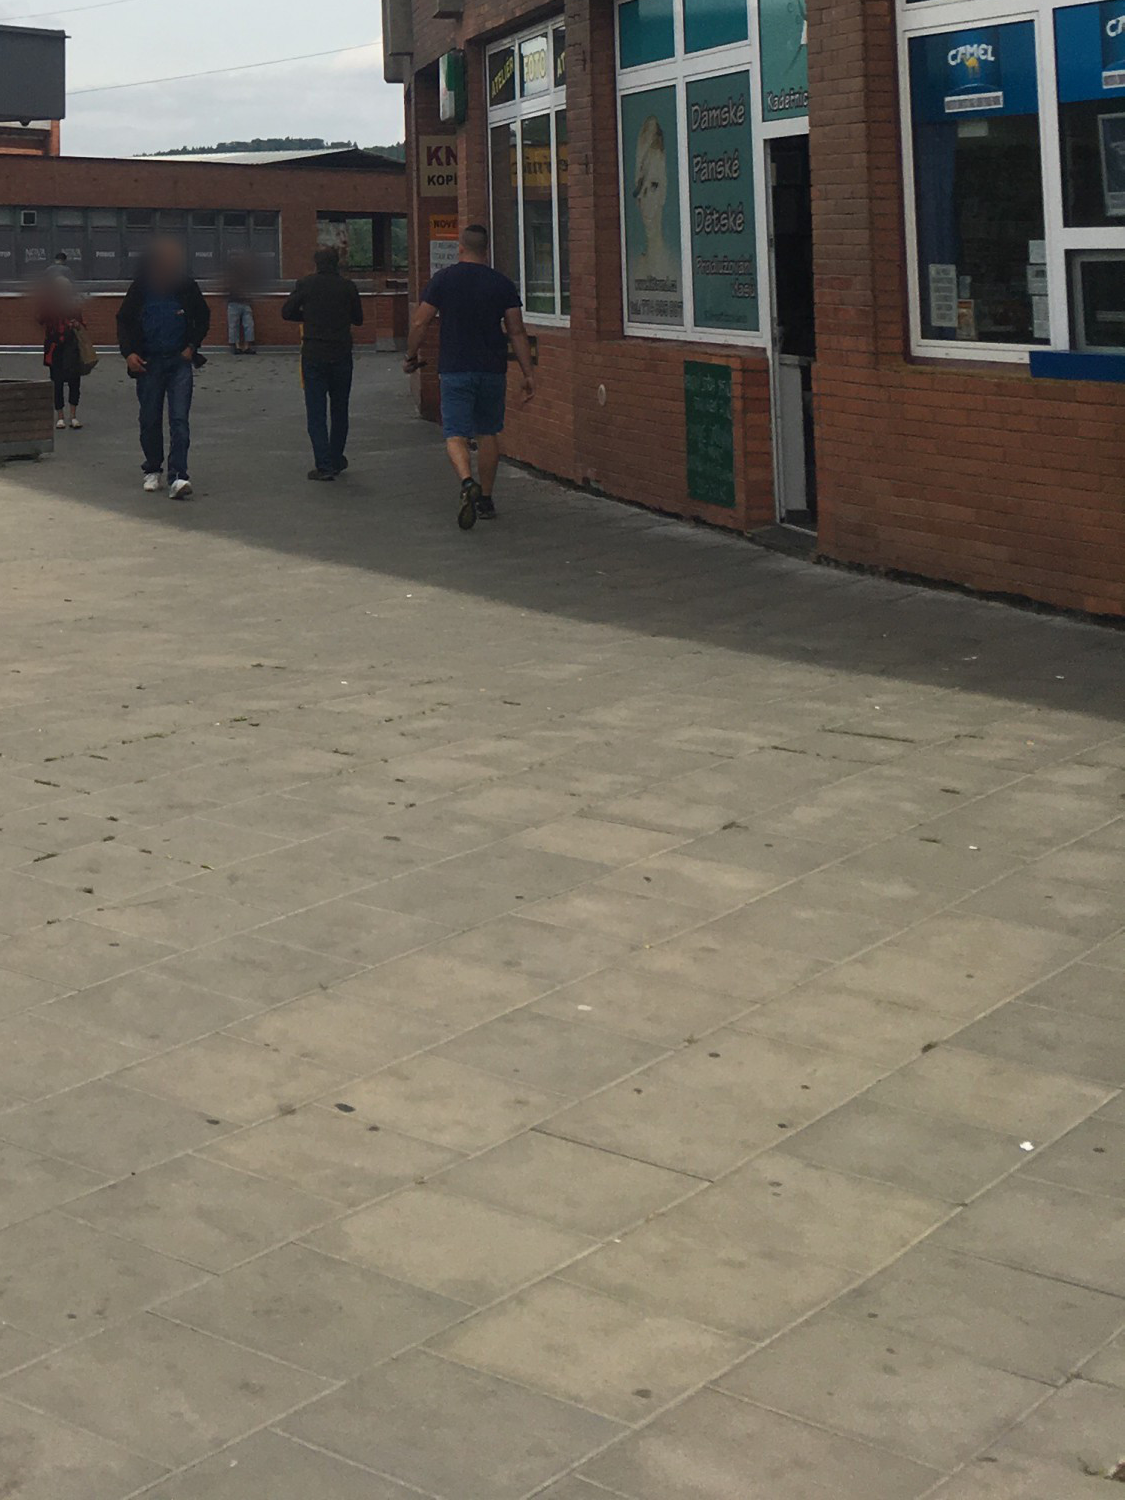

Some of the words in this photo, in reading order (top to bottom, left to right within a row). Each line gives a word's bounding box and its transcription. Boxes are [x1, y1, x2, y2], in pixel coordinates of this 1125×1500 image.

[523, 49, 547, 84] FOTO
[947, 43, 995, 66] CAMEL
[690, 93, 745, 132] Dámské
[692, 148, 740, 184] Pánské
[694, 202, 745, 235] Dětské
